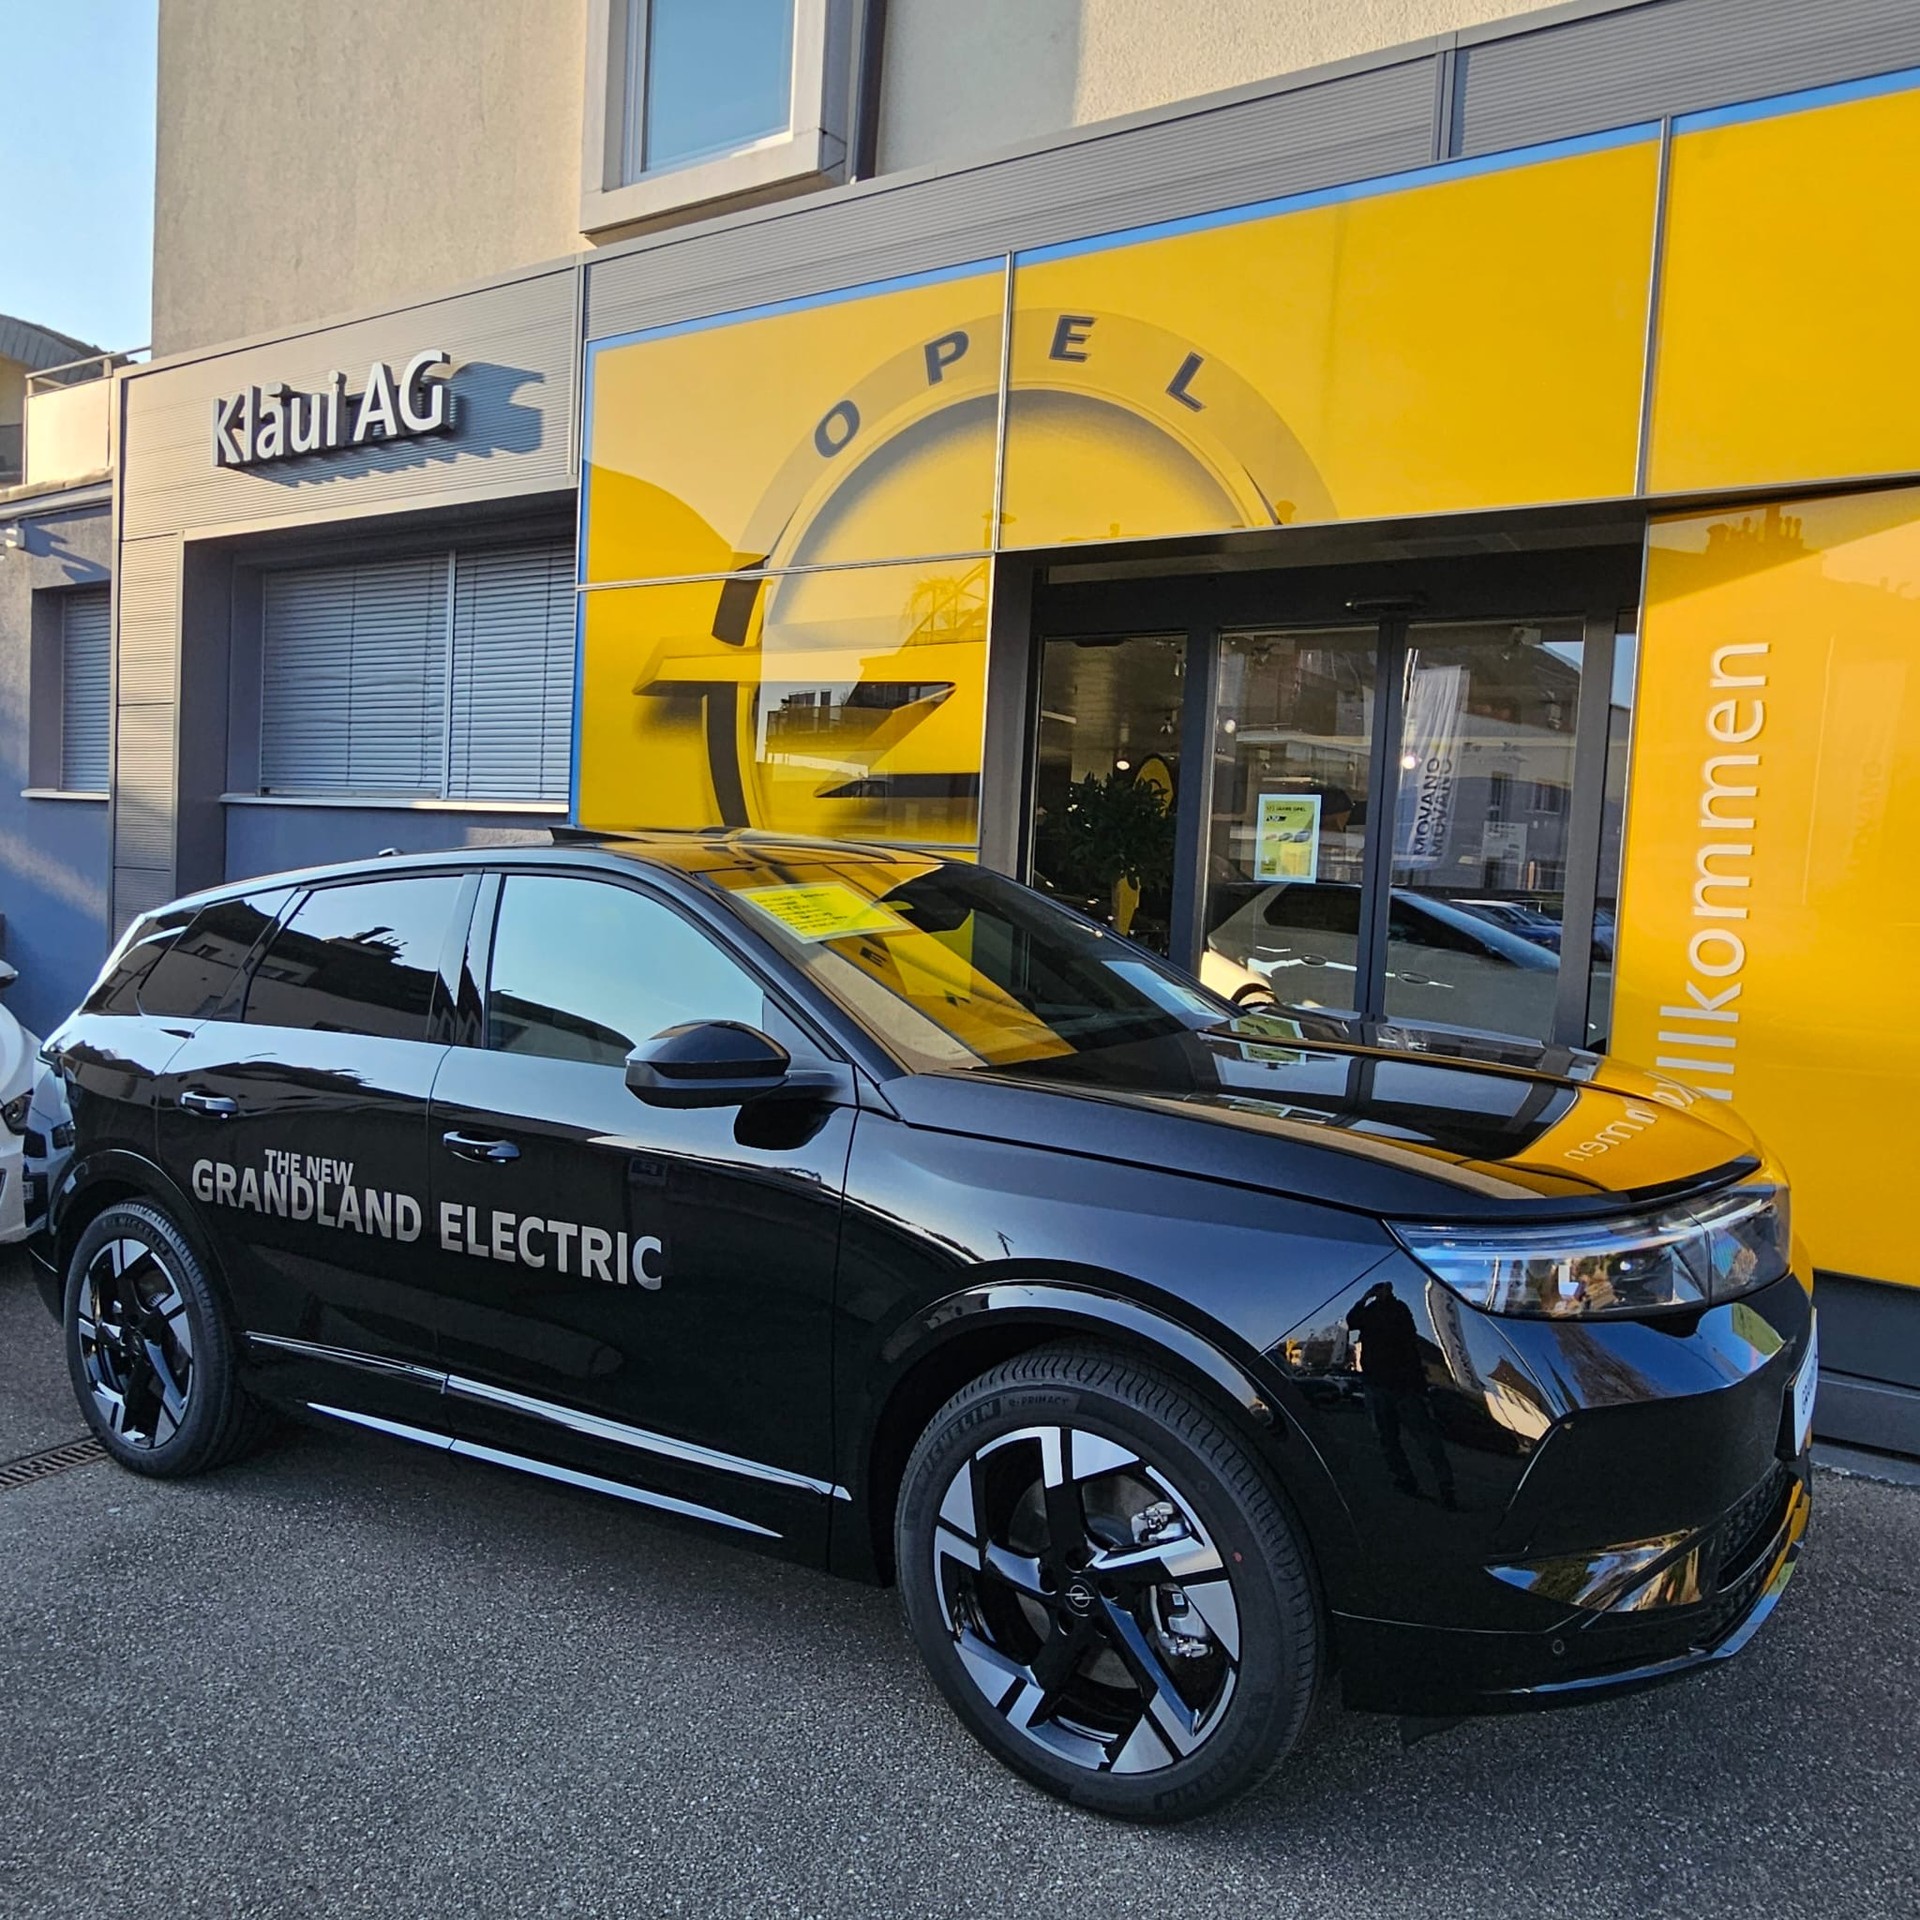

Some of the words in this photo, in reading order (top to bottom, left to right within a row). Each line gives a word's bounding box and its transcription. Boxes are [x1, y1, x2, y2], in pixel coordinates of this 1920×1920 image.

[353, 350, 450, 441] AG
[814, 314, 1206, 458] OPEL
[1413, 757, 1440, 856] MOVANO
[1656, 642, 1769, 1100] llkommen
[192, 1159, 422, 1242] GRANDLAND
[440, 1202, 662, 1290] ELECTRIC
[264, 1149, 301, 1179] THE
[306, 1156, 354, 1185] NEW
